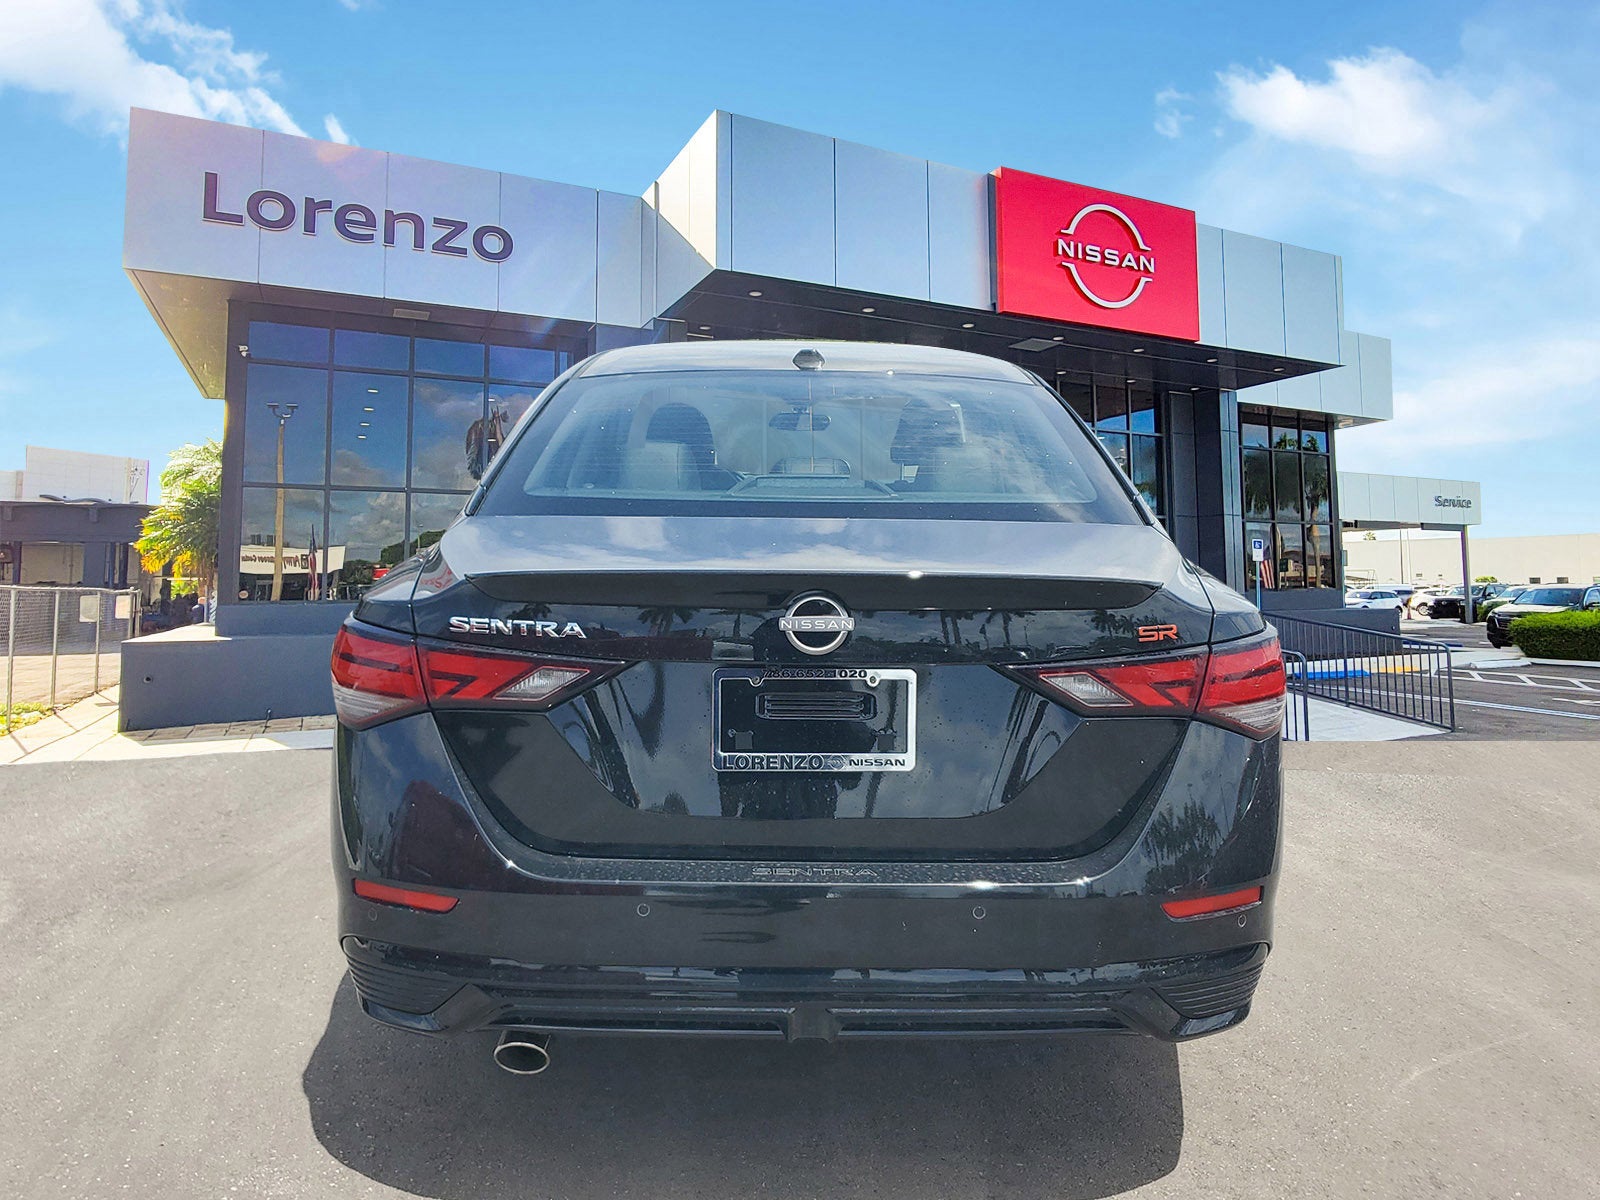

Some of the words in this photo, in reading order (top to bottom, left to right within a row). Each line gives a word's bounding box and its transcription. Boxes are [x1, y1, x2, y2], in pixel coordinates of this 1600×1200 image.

[202, 171, 513, 262] Lorenzo
[1057, 238, 1155, 273] NISSAN
[1434, 495, 1472, 508] Service
[449, 616, 587, 639] SENTRA
[780, 620, 853, 630] NISSAN
[1138, 624, 1178, 642] SR
[722, 754, 824, 771] LORENZO
[849, 758, 906, 767] NISSAN
[752, 867, 878, 876] SENTRA
